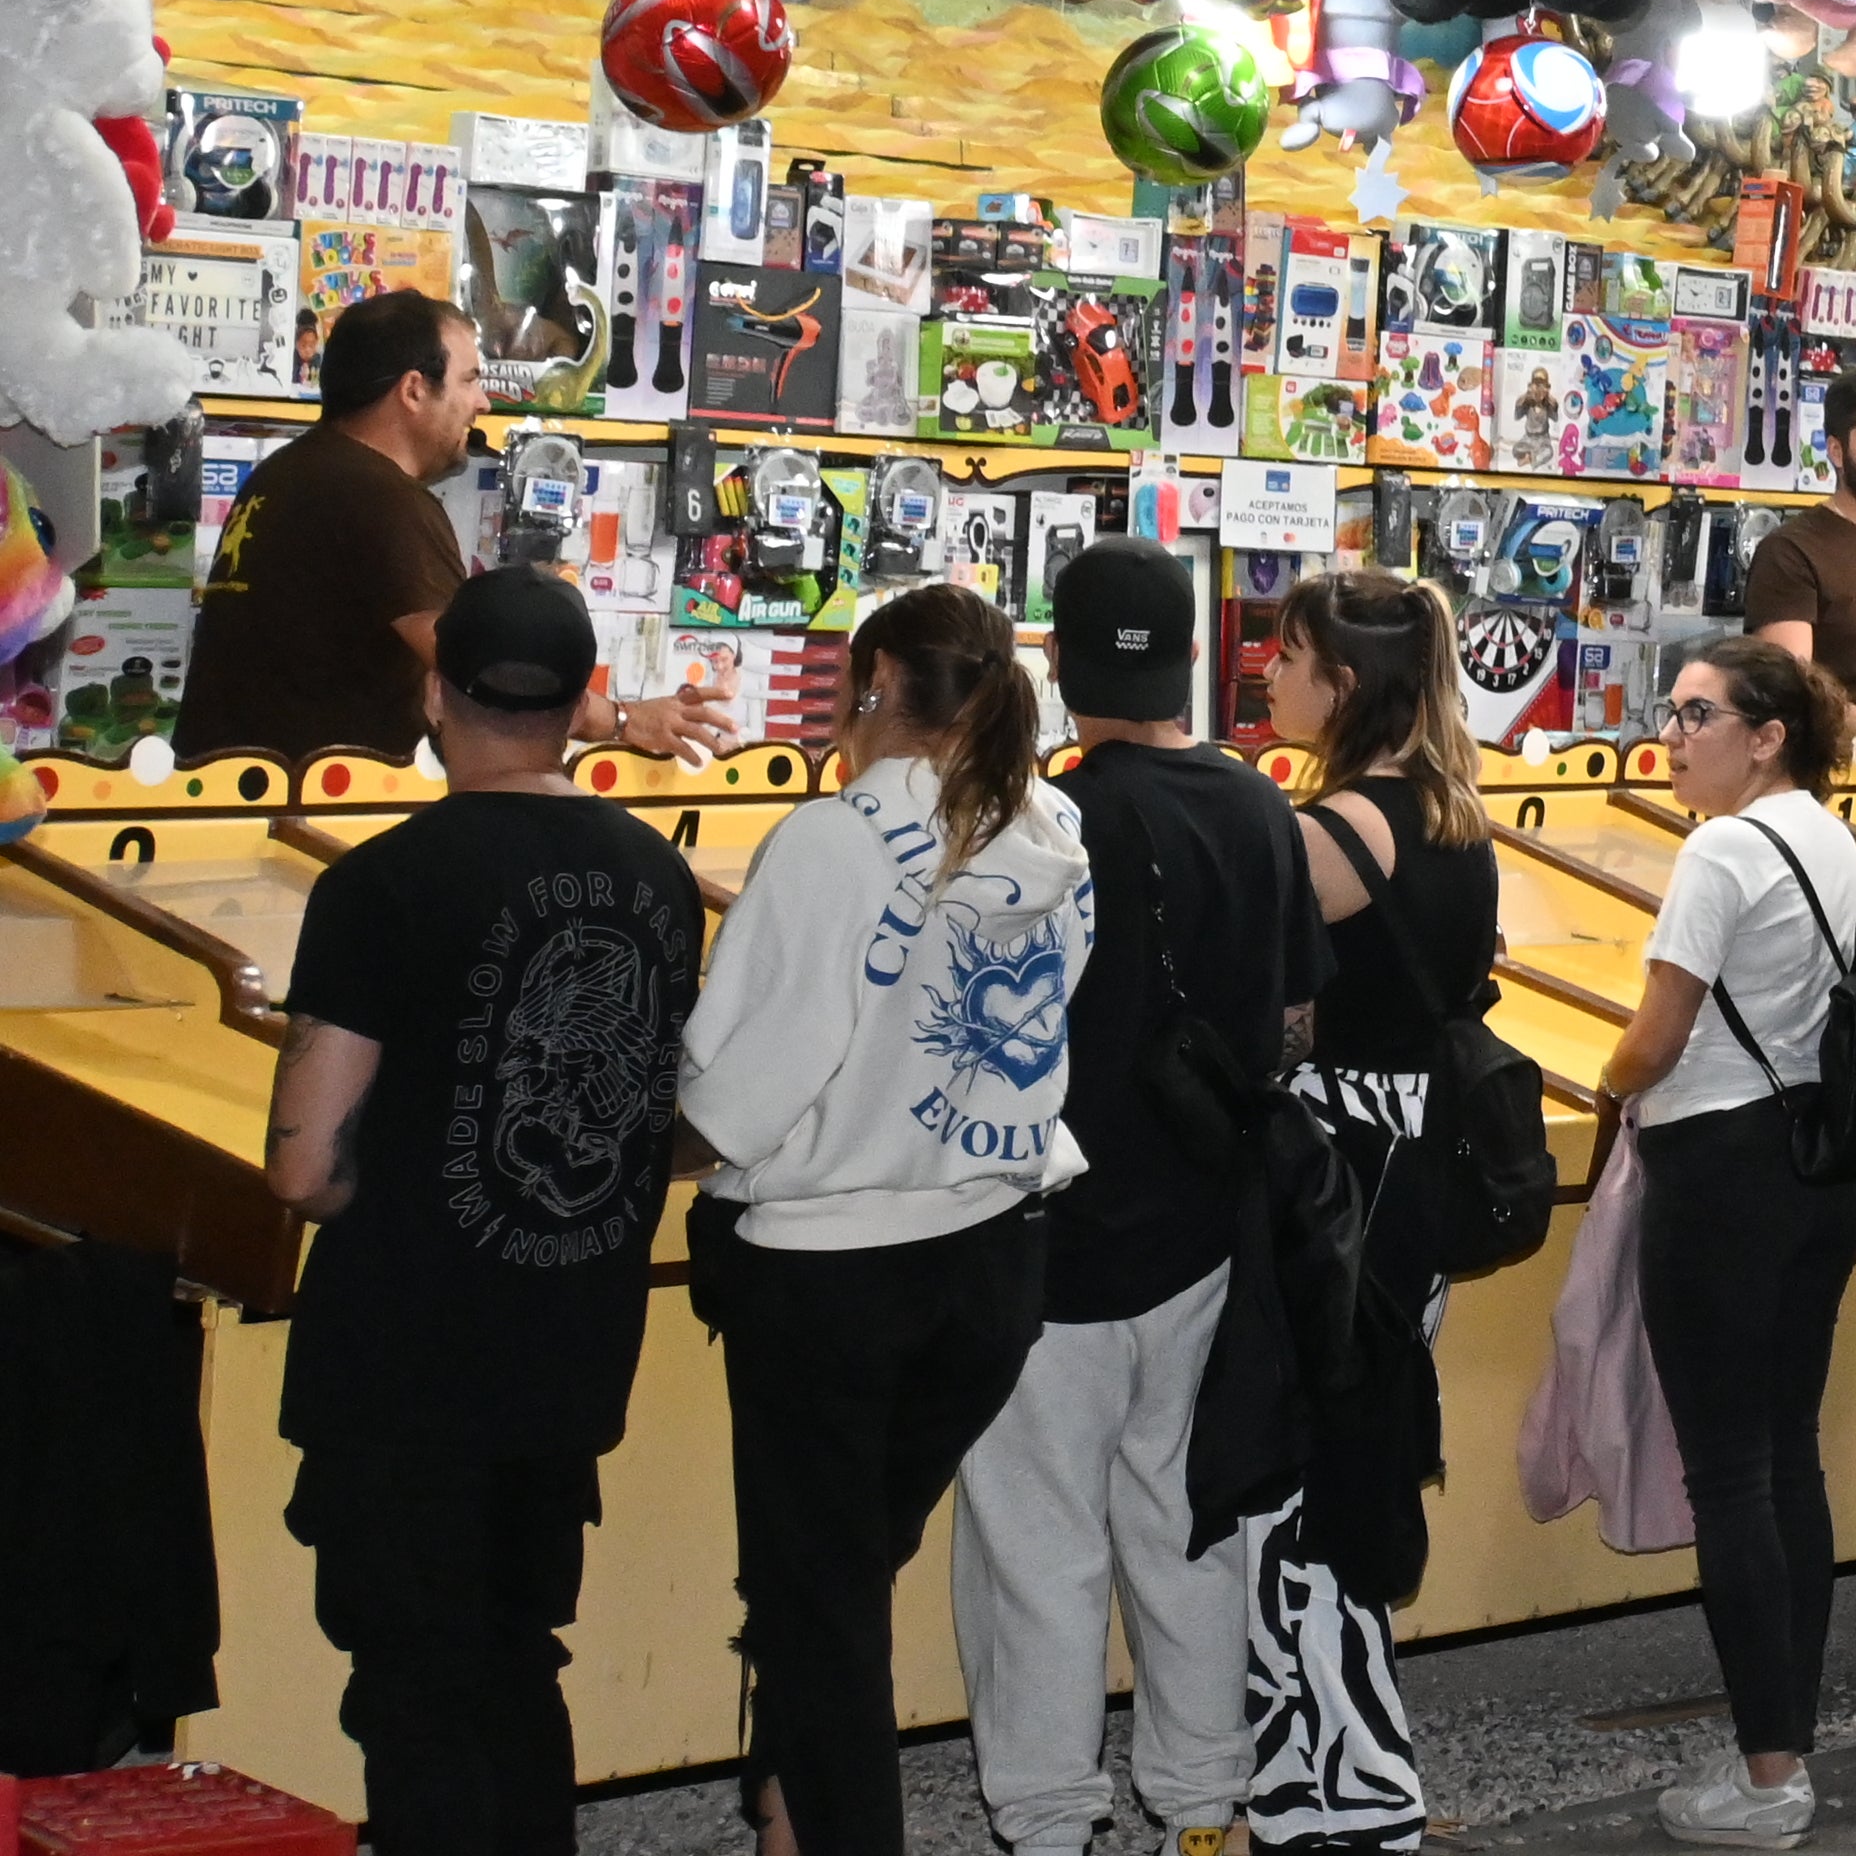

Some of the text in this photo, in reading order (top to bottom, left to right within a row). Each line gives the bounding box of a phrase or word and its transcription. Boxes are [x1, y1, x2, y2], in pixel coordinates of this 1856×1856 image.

[203, 95, 277, 115] PRITECH
[151, 263, 176, 285] MY
[151, 293, 261, 321] FAVORITE
[1248, 499, 1309, 515] ACEPTAMOS
[1536, 505, 1590, 521] PRITECH
[1226, 511, 1331, 530] PAGO CON TARJETA
[1492, 674, 1499, 688] 3
[1507, 672, 1517, 686] 17
[528, 871, 615, 918] FOR
[458, 907, 521, 1064] SLOW
[443, 1085, 491, 1228] MADE
[502, 1216, 626, 1268] NOMAD
